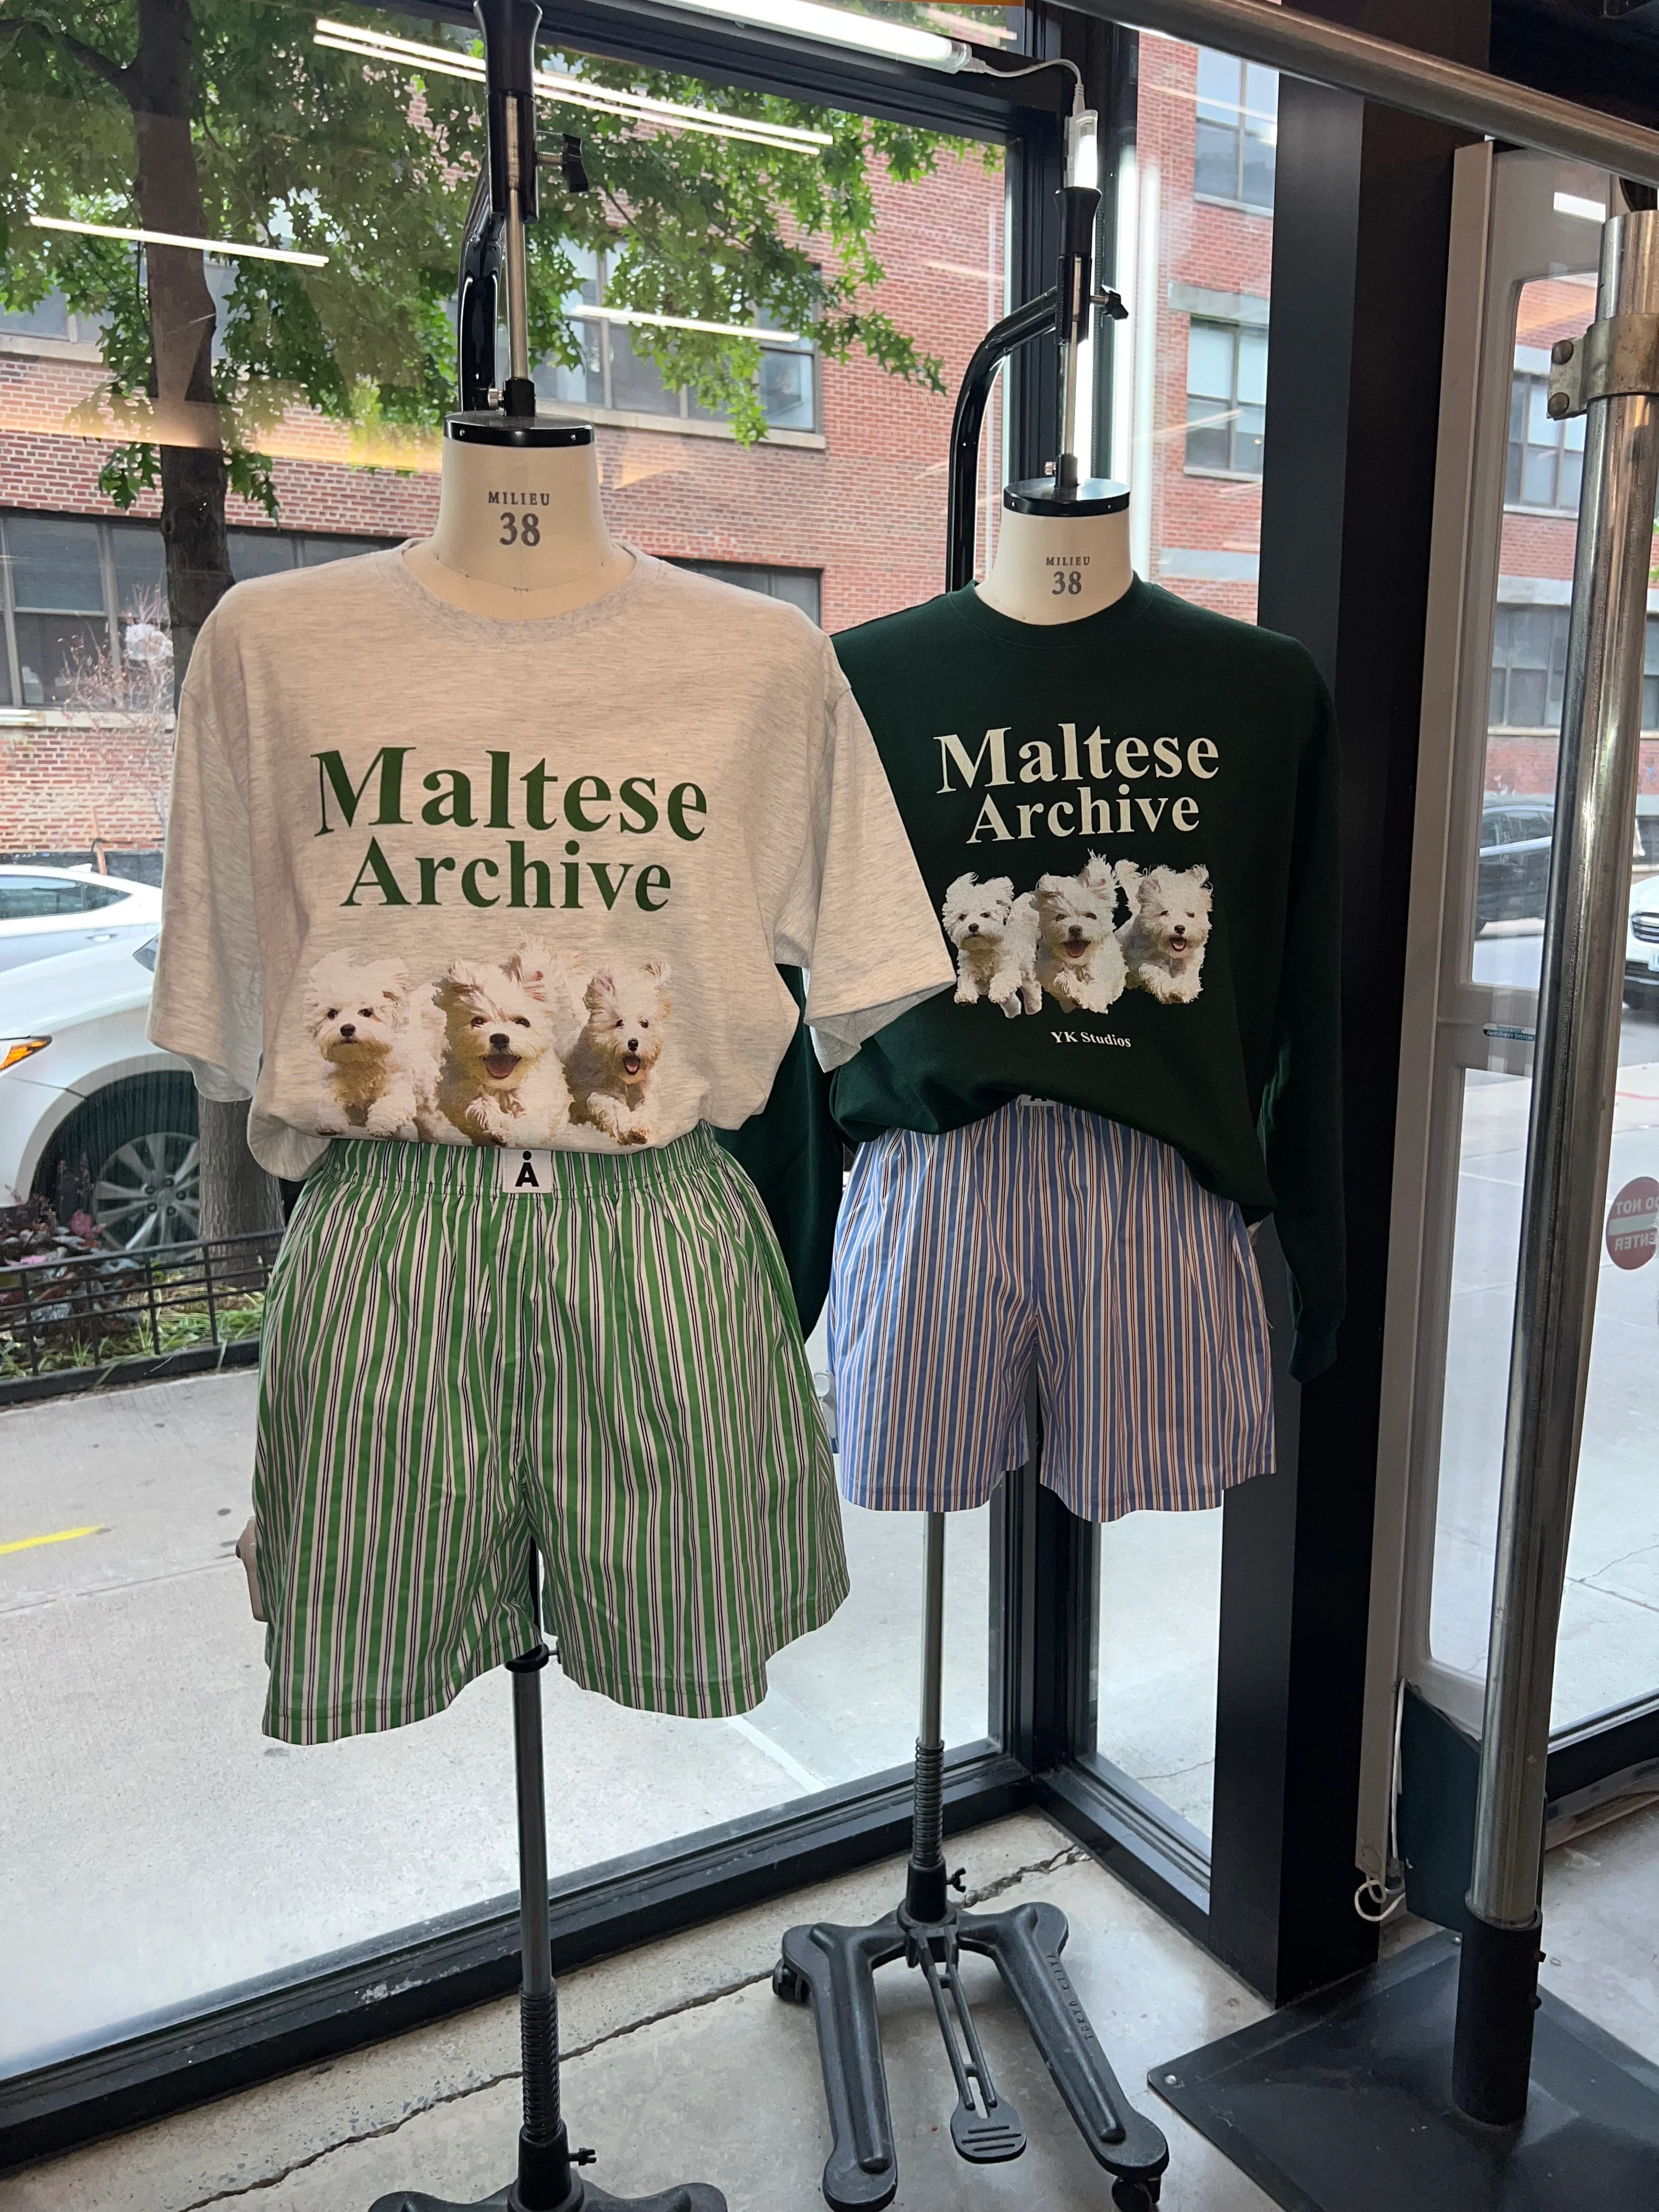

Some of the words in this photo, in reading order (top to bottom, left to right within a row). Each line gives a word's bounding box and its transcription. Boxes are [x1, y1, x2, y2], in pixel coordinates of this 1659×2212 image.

[488, 491, 550, 506] MILIEU
[499, 511, 541, 547] 38
[1045, 556, 1091, 566] MILIEU
[1052, 571, 1082, 595] 38
[933, 723, 1220, 794] Maltese
[310, 747, 708, 841] Maltese
[966, 783, 1200, 844] Archive
[339, 836, 671, 912] Archive
[1051, 1030, 1079, 1044] YK
[1080, 1031, 1132, 1048] Studios
[1068, 2000, 1094, 2041] TOKYO
